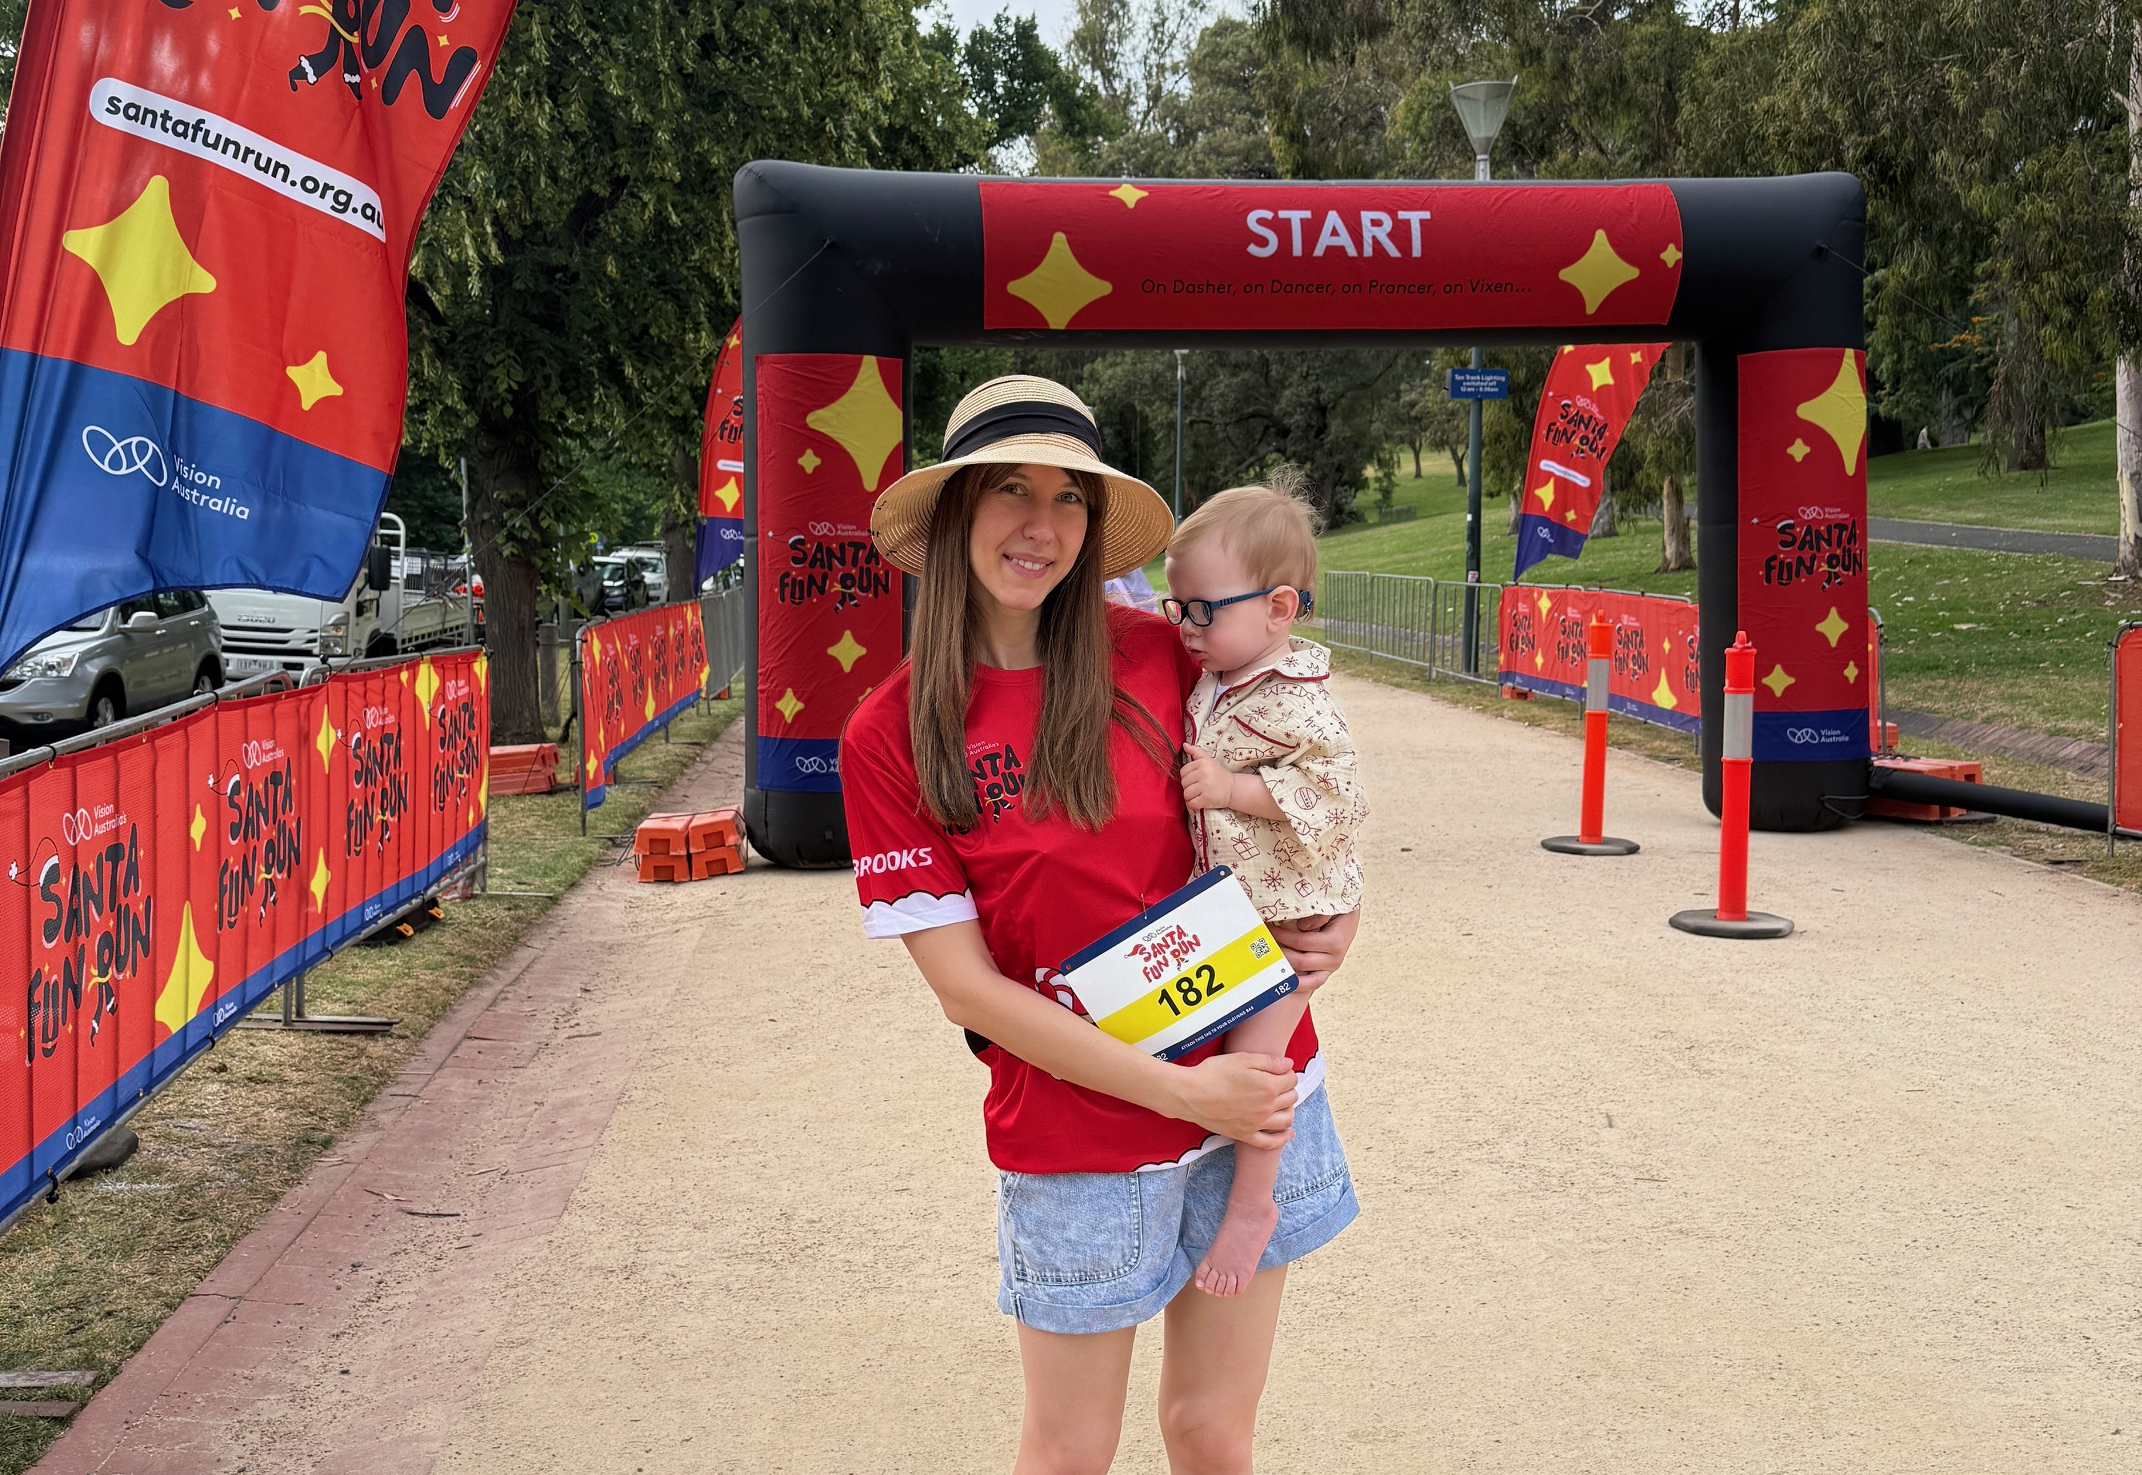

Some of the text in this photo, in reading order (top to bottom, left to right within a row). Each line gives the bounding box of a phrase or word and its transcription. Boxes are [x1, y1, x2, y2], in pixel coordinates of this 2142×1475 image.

[104, 94, 386, 232] santafunrun.org.au
[1246, 209, 1431, 258] START
[1141, 278, 1532, 297] On Dasher, on Dancer, on Prancer, on Vixen...
[1558, 400, 1608, 441] SANTA
[173, 453, 221, 490] Vision
[171, 475, 250, 520] Australia
[788, 535, 881, 572] SANTA
[1776, 519, 1858, 553] SANTA
[779, 571, 829, 606] FUN
[831, 566, 891, 614] RUN
[1764, 553, 1817, 587] FUN
[1819, 547, 1863, 593] RUN
[352, 722, 402, 789] SANTA
[967, 740, 986, 750] Vision
[970, 744, 1022, 790] NTA
[93, 802, 115, 820] Vision
[227, 757, 295, 844] SANTA
[346, 790, 375, 859] FUN
[39, 823, 142, 947] SANTA
[217, 845, 257, 933] FUN
[1139, 924, 1187, 963] SANTA
[1170, 934, 1201, 972] RUN
[90, 895, 152, 1048] RUN
[1142, 955, 1169, 984] FUN
[1158, 964, 1225, 1016] 182
[1275, 982, 1291, 996] 182
[27, 943, 86, 1064] FUN
